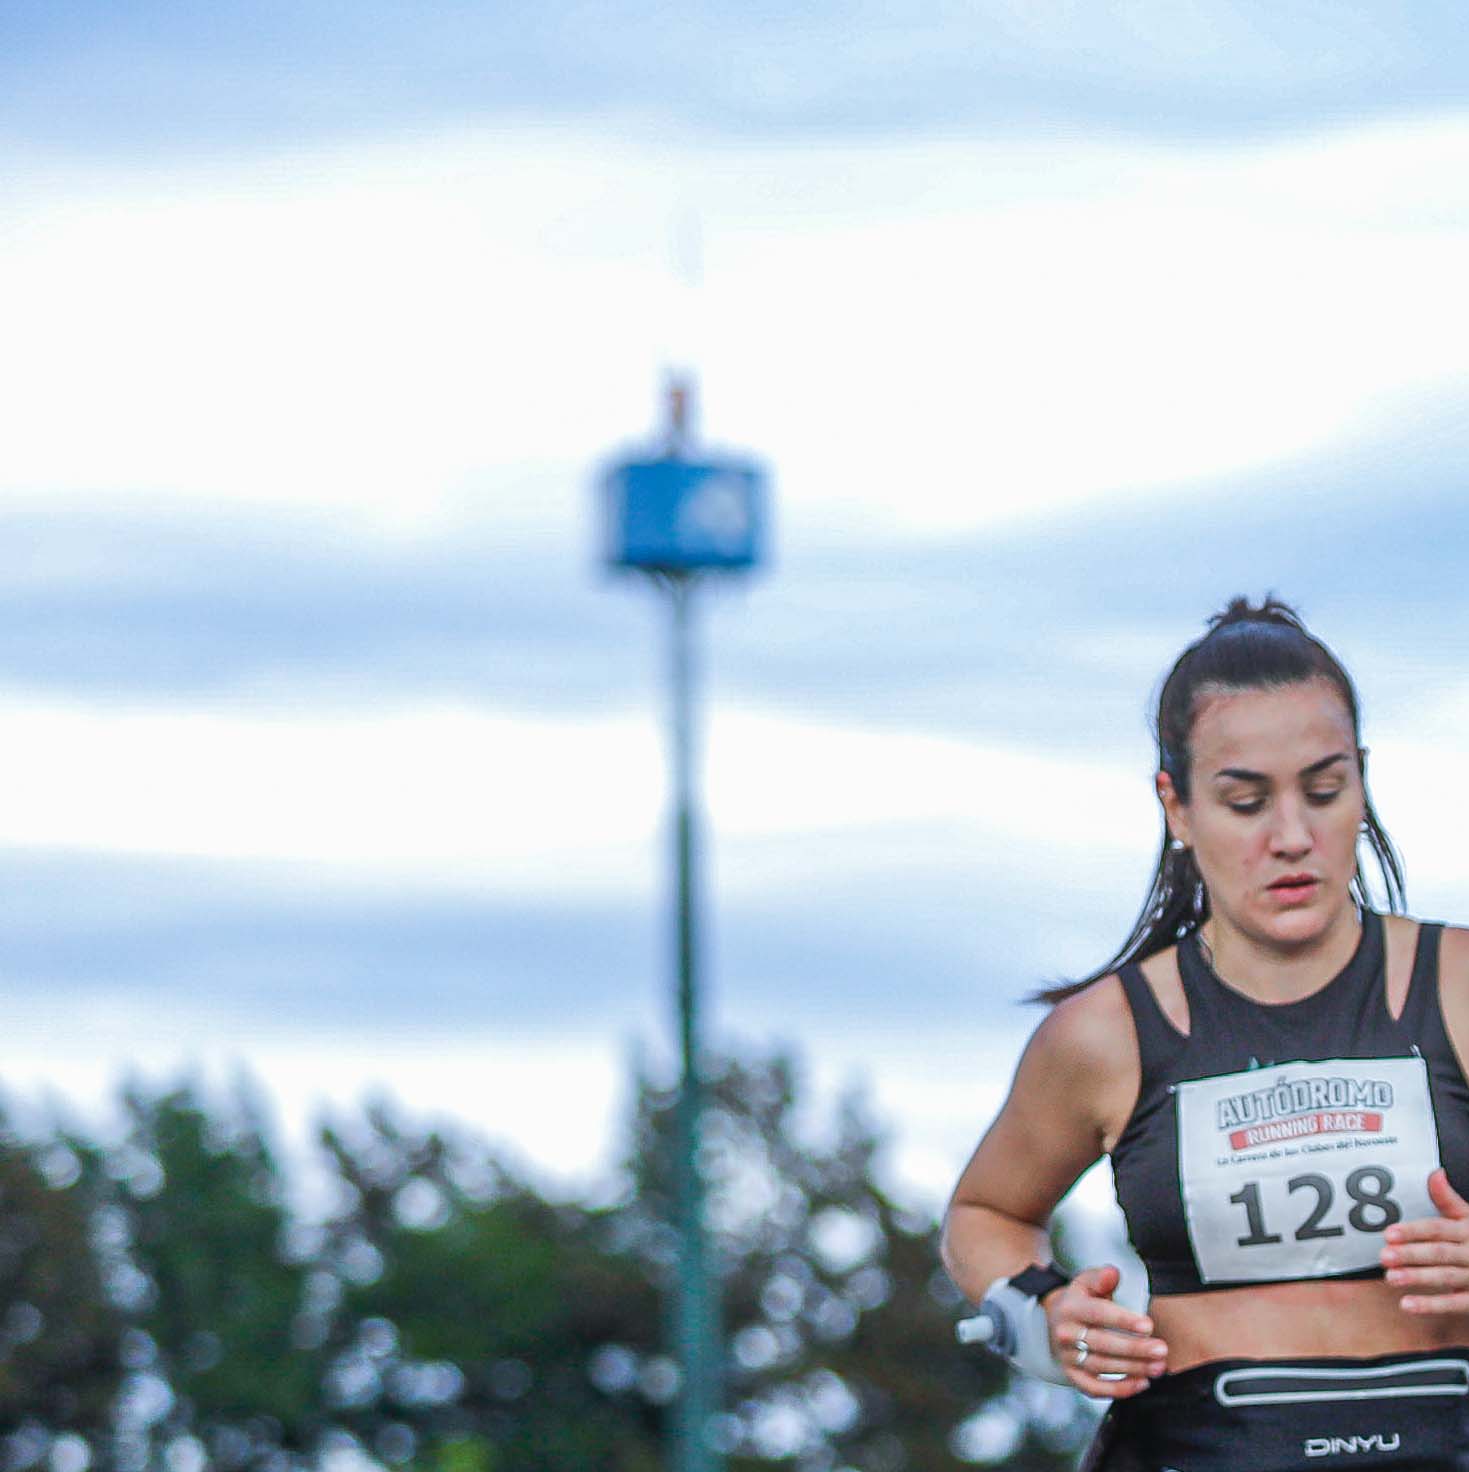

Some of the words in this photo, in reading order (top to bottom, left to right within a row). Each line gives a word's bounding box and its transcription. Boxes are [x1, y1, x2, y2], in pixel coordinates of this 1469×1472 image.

[1216, 1075, 1395, 1130] AUTÓDROMO
[1246, 1116, 1319, 1147] RUNNING
[1321, 1112, 1366, 1133] RACE
[1230, 1165, 1402, 1247] 128
[1304, 1432, 1400, 1458] DINYU
